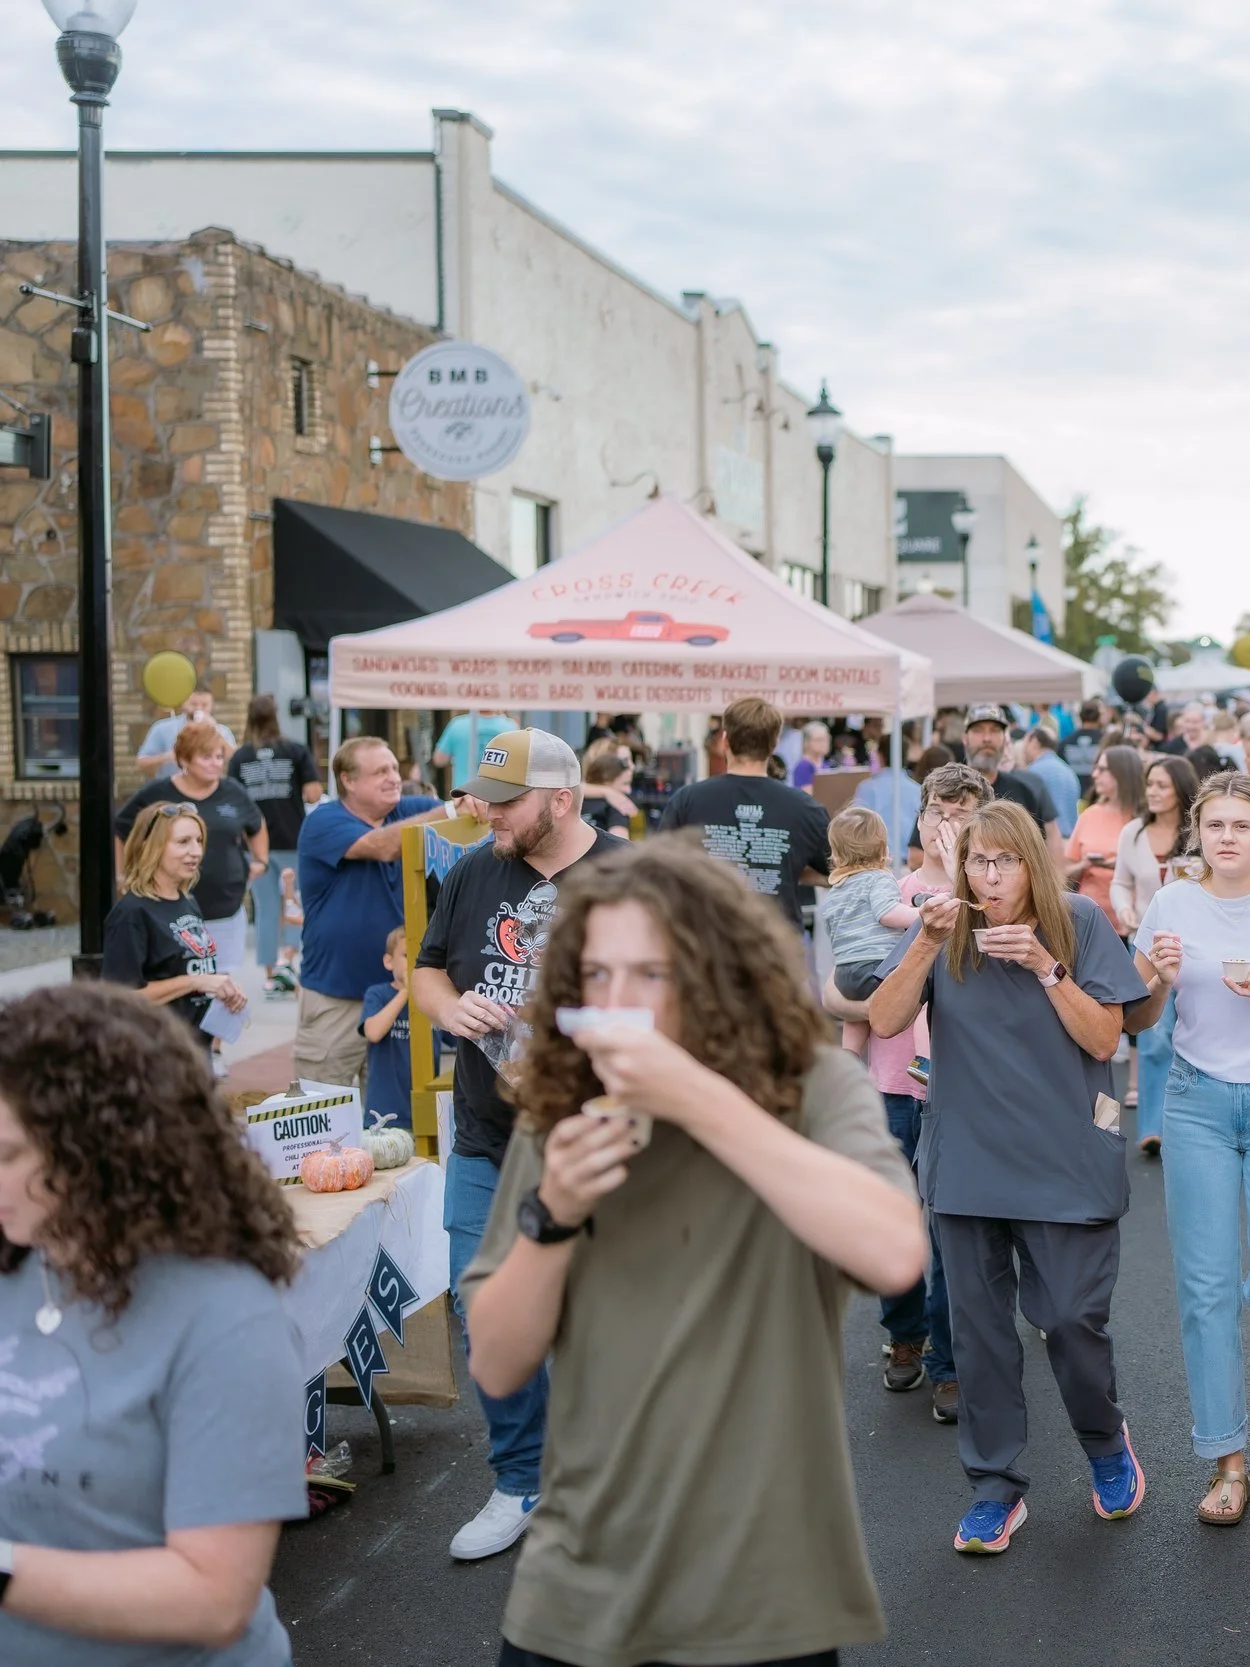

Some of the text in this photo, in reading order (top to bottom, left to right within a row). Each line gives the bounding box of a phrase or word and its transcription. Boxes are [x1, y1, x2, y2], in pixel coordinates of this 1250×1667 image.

[428, 368, 488, 384] BMB
[395, 387, 525, 422] Creations
[531, 572, 746, 606] CROSS CREEK
[483, 751, 505, 764] YETI
[484, 962, 541, 990] CHI
[273, 1113, 331, 1140] CAUTION:
[282, 1139, 323, 1151] PROFESSIONAL
